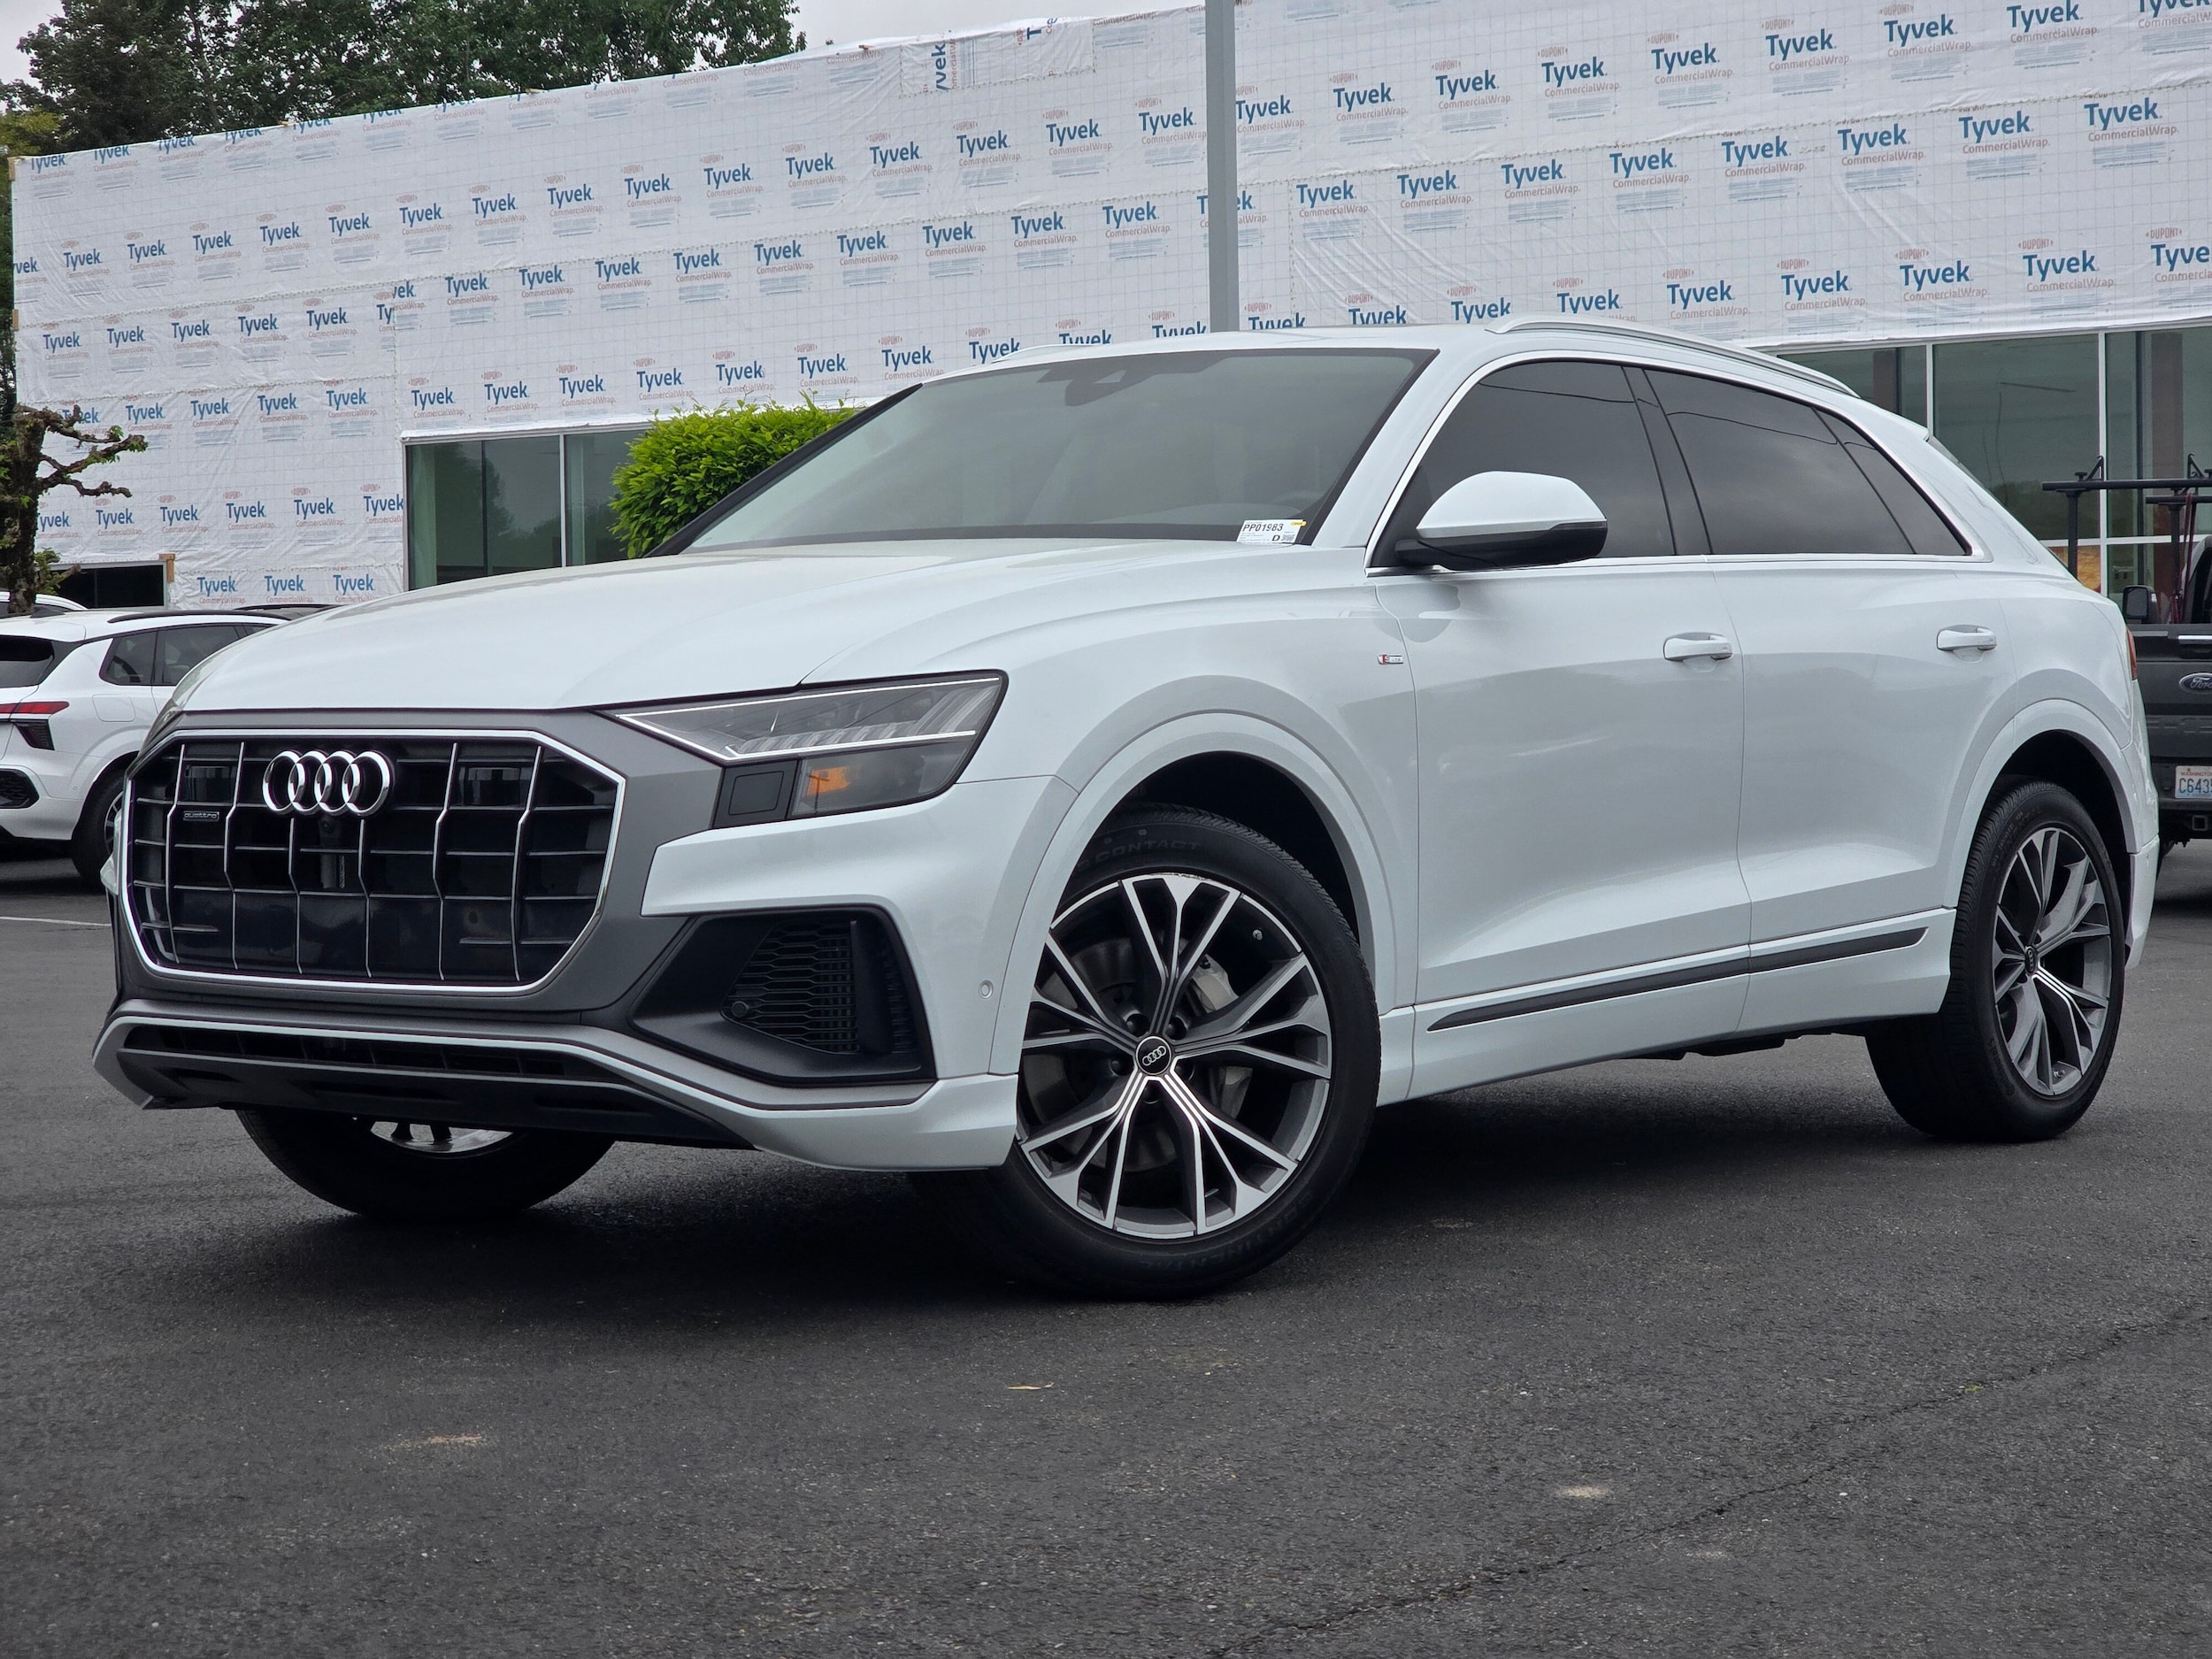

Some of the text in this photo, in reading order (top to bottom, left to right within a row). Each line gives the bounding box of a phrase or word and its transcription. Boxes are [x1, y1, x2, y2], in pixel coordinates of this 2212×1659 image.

[1884, 14, 1954, 47] Tyvek
[1765, 28, 1833, 61] Tyvek
[1651, 42, 1717, 74] Tyvek
[1435, 69, 1496, 100] Tyvek
[1541, 57, 1604, 88] Tyvek
[1333, 82, 1392, 112] Tyvek
[1139, 107, 1194, 135] Tyvek
[1959, 111, 2030, 143] Tyvek
[2084, 97, 2158, 131] Tyvek
[956, 130, 1008, 157] Tyvek
[1046, 119, 1099, 147] Tyvek
[1838, 123, 1907, 156] Tyvek
[870, 142, 919, 168] Tyvek
[1609, 148, 1673, 179] Tyvek
[1722, 135, 1788, 167] Tyvek
[703, 163, 751, 189] Tyvek
[786, 152, 836, 179] Tyvek
[1502, 158, 1563, 189] Tyvek
[548, 183, 594, 209] Tyvek
[625, 173, 670, 199] Tyvek
[1296, 180, 1354, 208] Tyvek
[1397, 170, 1459, 199] Tyvek
[399, 203, 444, 227] Tyvek
[472, 193, 516, 219] Tyvek
[1102, 201, 1156, 229] Tyvek
[260, 222, 302, 246] Tyvek
[328, 212, 373, 236] Tyvek
[922, 221, 973, 248] Tyvek
[1010, 211, 1064, 239] Tyvek
[127, 240, 167, 263] Tyvek
[193, 231, 234, 254] Tyvek
[754, 240, 802, 266] Tyvek
[837, 231, 886, 257] Tyvek
[63, 249, 103, 271] Tyvek
[595, 257, 642, 282] Tyvek
[673, 247, 722, 274] Tyvek
[2023, 250, 2100, 282] Tyvek
[2150, 243, 2211, 272] Tyve
[444, 273, 489, 297] Tyvek
[518, 265, 565, 290] Tyvek
[1781, 270, 1852, 301] Tyvek
[1900, 260, 1973, 292] Tyvek
[1557, 289, 1620, 314] Tyvek
[1667, 280, 1732, 310] Tyvek
[172, 319, 210, 342] Tyvek
[238, 313, 279, 336] Tyvek
[306, 307, 349, 330] Tyvek
[42, 331, 81, 353] Tyvek
[107, 326, 146, 348] Tyvek
[797, 353, 846, 379] Tyvek
[881, 345, 932, 372] Tyvek
[636, 368, 684, 392] Tyvek
[716, 360, 764, 386] Tyvek
[326, 388, 368, 411] Tyvek
[411, 387, 456, 411] Tyvek
[484, 380, 530, 404] Tyvek
[559, 374, 606, 399] Tyvek
[126, 403, 165, 425] Tyvek
[190, 397, 230, 420] Tyvek
[257, 393, 298, 415] Tyvek
[96, 508, 134, 529] Tyvek
[160, 504, 200, 526] Tyvek
[226, 501, 266, 523] Tyvek
[294, 497, 335, 520] Tyvek
[40, 511, 70, 533] yvek
[1242, 523, 1284, 532] PP01983
[197, 576, 238, 596] Tyvek
[265, 574, 305, 595] Tyvek
[333, 574, 375, 595] Tyvek
[2178, 778, 2212, 794] C643
